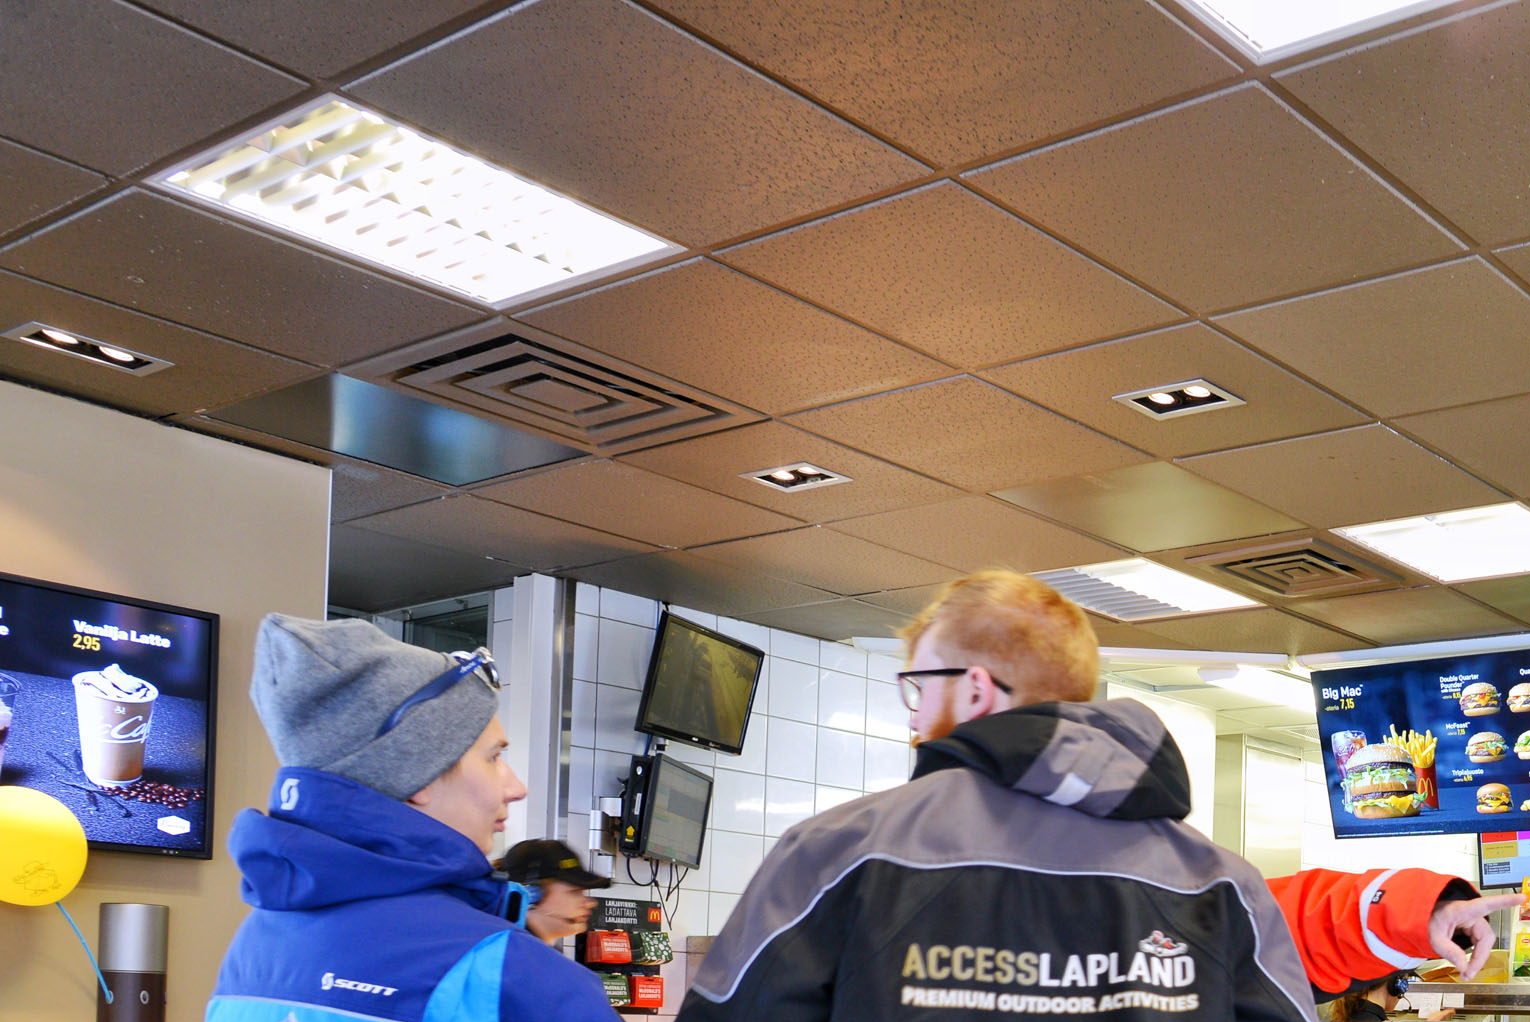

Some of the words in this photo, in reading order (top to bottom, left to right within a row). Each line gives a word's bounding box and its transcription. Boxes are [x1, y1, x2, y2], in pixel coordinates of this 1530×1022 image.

[73, 619, 129, 641] Vanilja
[130, 629, 171, 648] Latte
[73, 633, 101, 652] 2,95
[1322, 687, 1339, 700] Big
[1340, 686, 1362, 698] Mac
[1340, 698, 1355, 710] 7,15
[605, 908, 637, 917] LADATTAVA
[902, 943, 1195, 989] ACCESSLAPLAND
[333, 978, 399, 996] SCOTT
[901, 985, 996, 1011] PREMIUM
[997, 993, 1097, 1014] OUTDOOR
[1099, 990, 1199, 1013] ACTIVITIES
